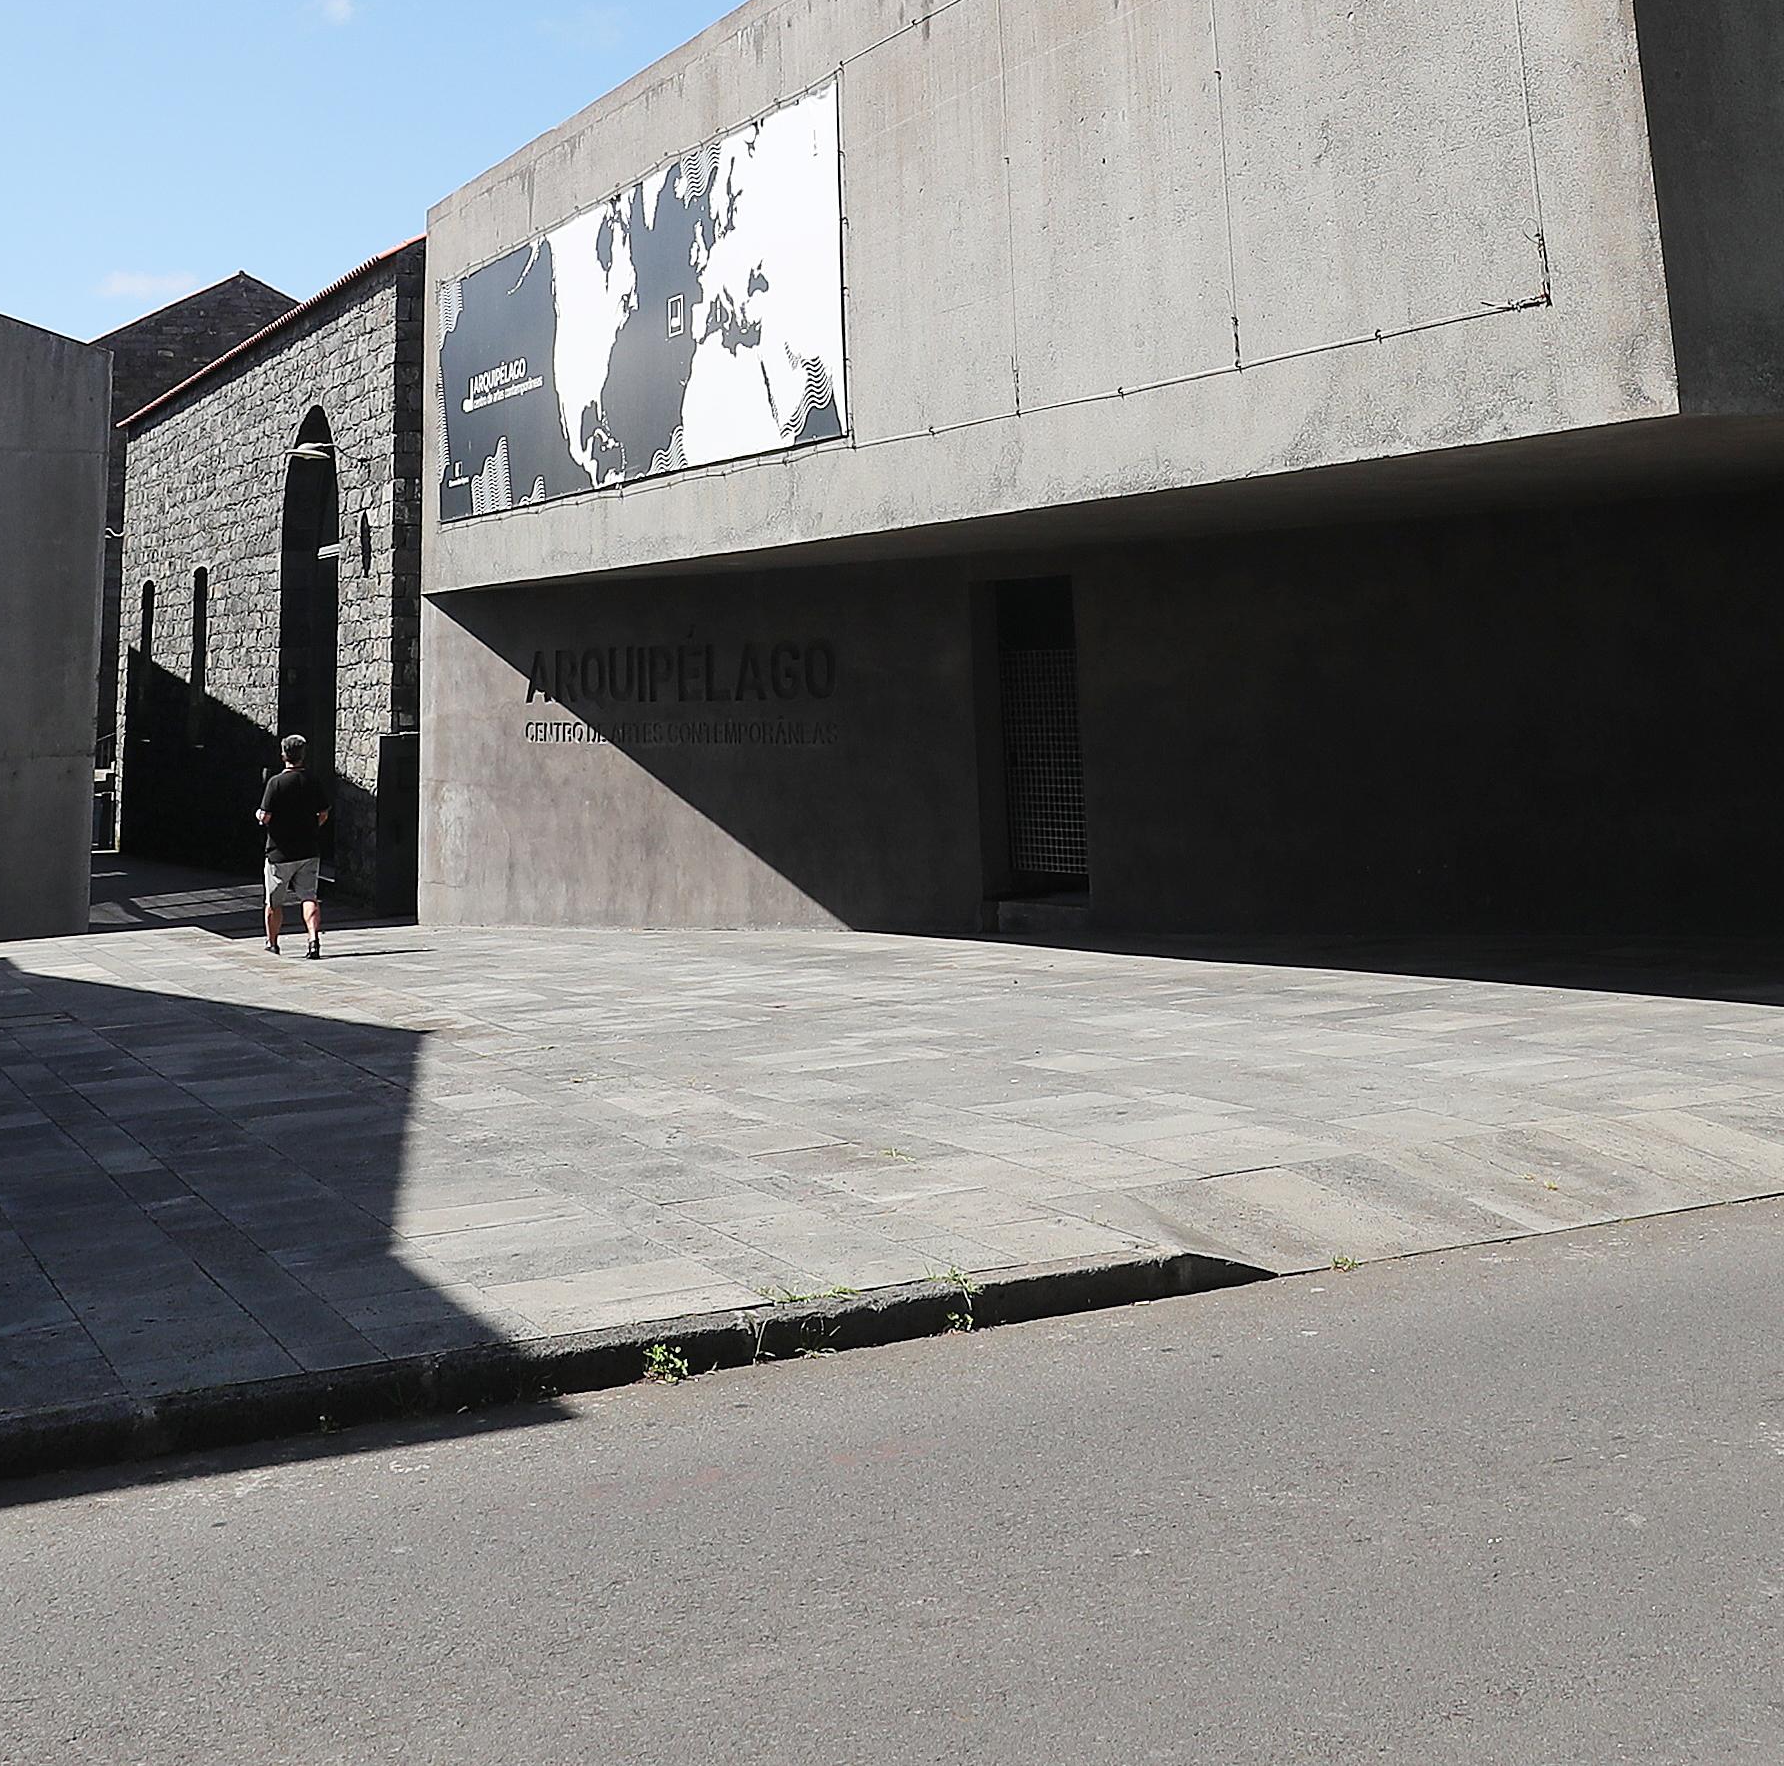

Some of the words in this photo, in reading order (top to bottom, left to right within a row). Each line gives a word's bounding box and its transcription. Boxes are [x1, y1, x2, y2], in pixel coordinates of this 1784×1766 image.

[473, 357, 527, 394] ARQUIPÉLAGO
[526, 624, 836, 706] ARQUIPÉLAGO
[525, 721, 583, 743] CENTRO
[586, 721, 607, 743] DE
[611, 721, 664, 744] ARTES
[668, 714, 840, 745] CONTEMPORÂNEAS
